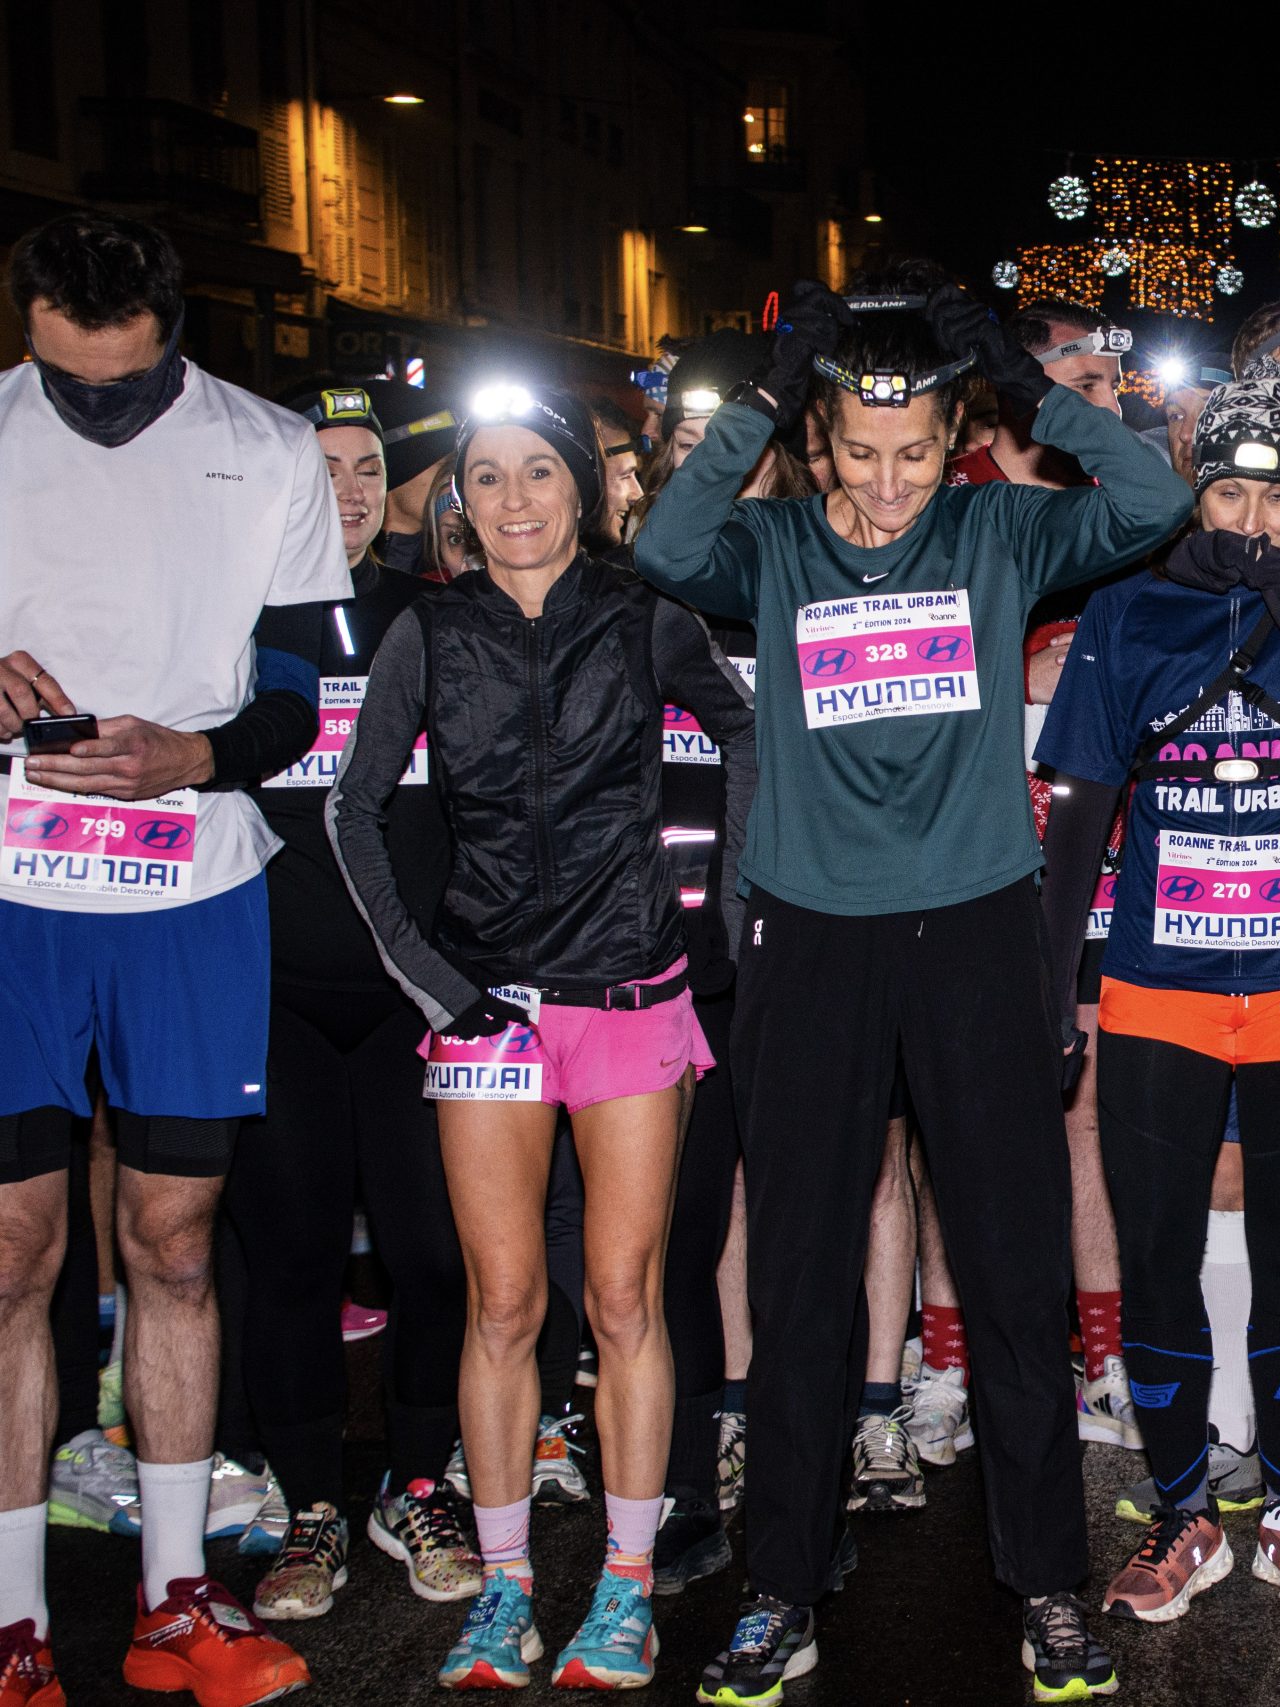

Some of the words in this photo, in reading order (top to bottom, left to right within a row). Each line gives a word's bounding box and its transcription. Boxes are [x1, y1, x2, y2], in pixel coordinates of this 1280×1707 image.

[1061, 343, 1081, 356] PETZL
[206, 472, 244, 482] ARTENGO
[805, 601, 859, 621] ROANNE
[863, 597, 903, 613] TRAIL
[907, 593, 957, 609] URBAIN
[894, 617, 912, 626] 2024
[865, 642, 908, 663] 328
[323, 682, 362, 693] TRAIL
[816, 675, 967, 714] HYUNDAI
[832, 710, 864, 723] Espace
[325, 719, 355, 735] 58
[670, 754, 697, 764] Espace
[286, 778, 316, 787] Espace
[1155, 785, 1224, 813] TRAIL
[80, 817, 126, 838] 799
[1169, 834, 1215, 850] ROANNE
[1219, 839, 1251, 852] TRAIL
[13, 851, 179, 888] HYUNDAI
[1242, 859, 1258, 867] 2024
[27, 878, 62, 890] Espace
[120, 885, 164, 897] Desnoyer
[1212, 882, 1251, 899] 270
[1175, 937, 1203, 947] Espace
[1204, 937, 1250, 948] Automobile
[439, 1090, 475, 1099] Automobile
